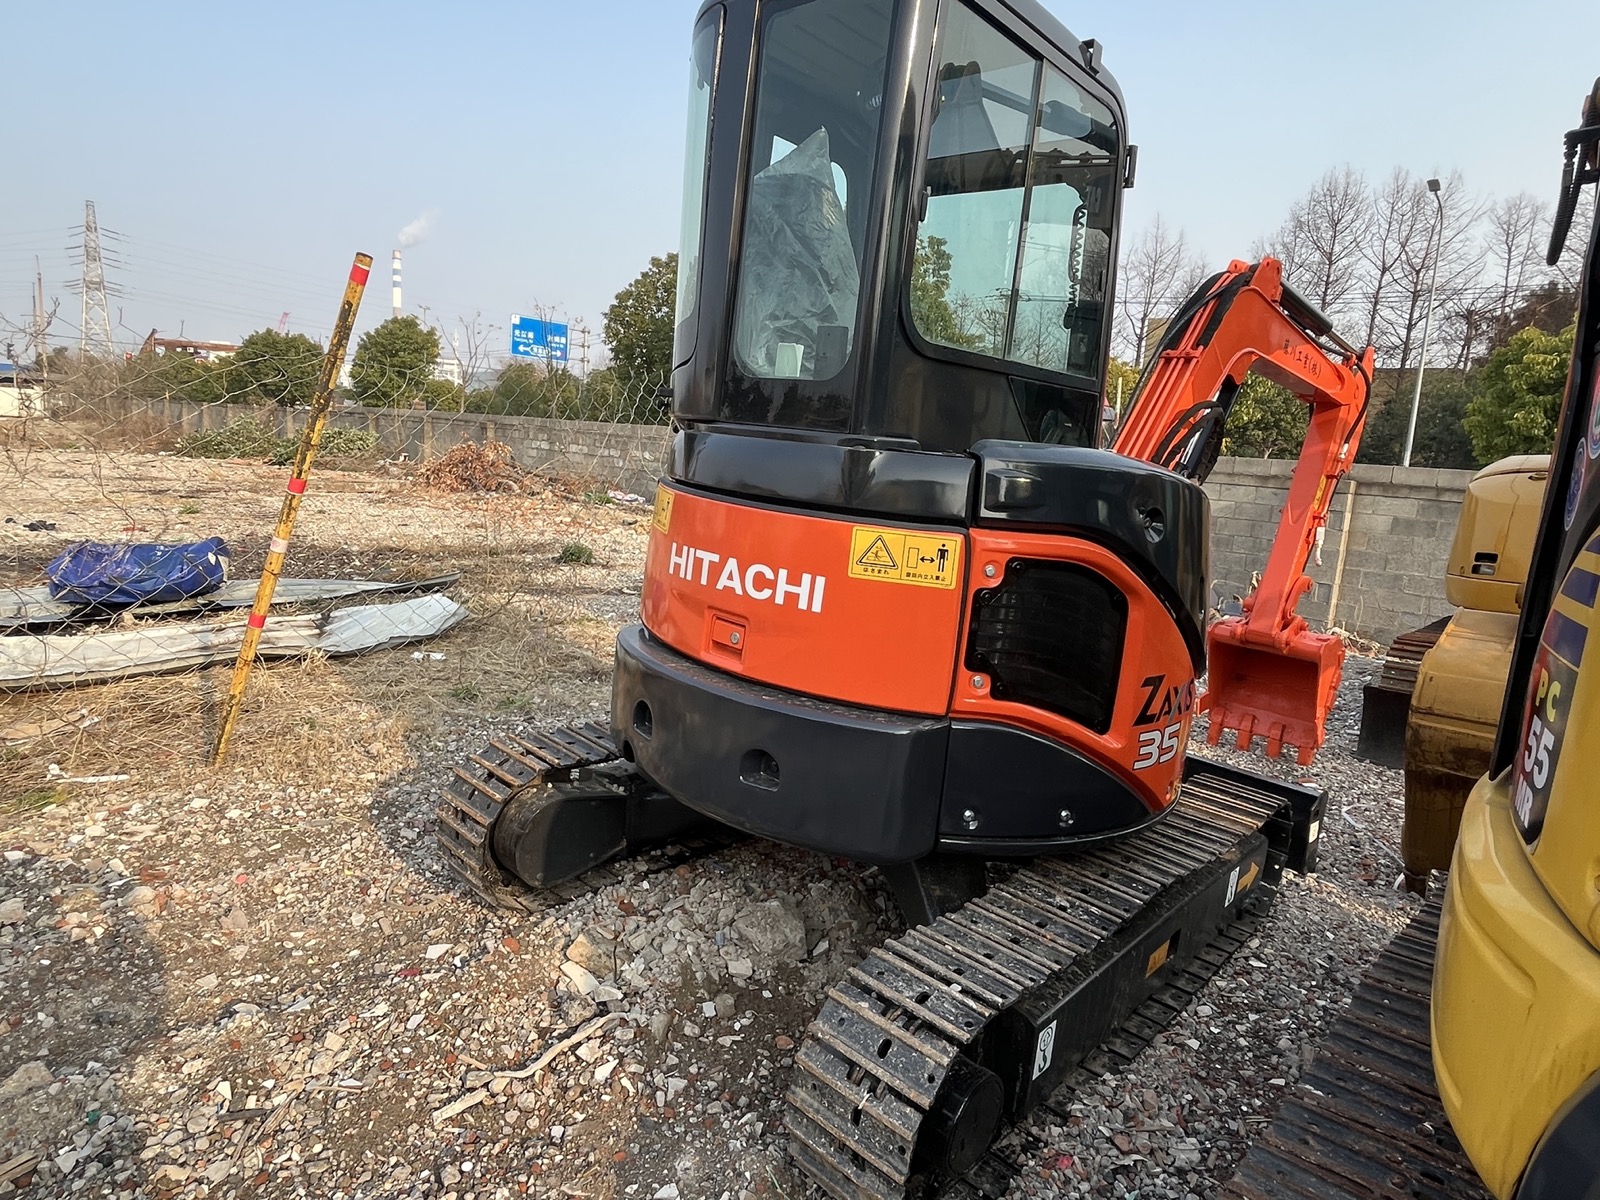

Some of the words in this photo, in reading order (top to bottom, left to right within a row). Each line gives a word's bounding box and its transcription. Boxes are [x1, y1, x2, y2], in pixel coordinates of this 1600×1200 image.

[669, 542, 825, 612] HITACHI
[1536, 668, 1561, 722] PC
[1132, 722, 1181, 770] 35
[1524, 715, 1554, 789] 55
[1515, 775, 1534, 828] MR
